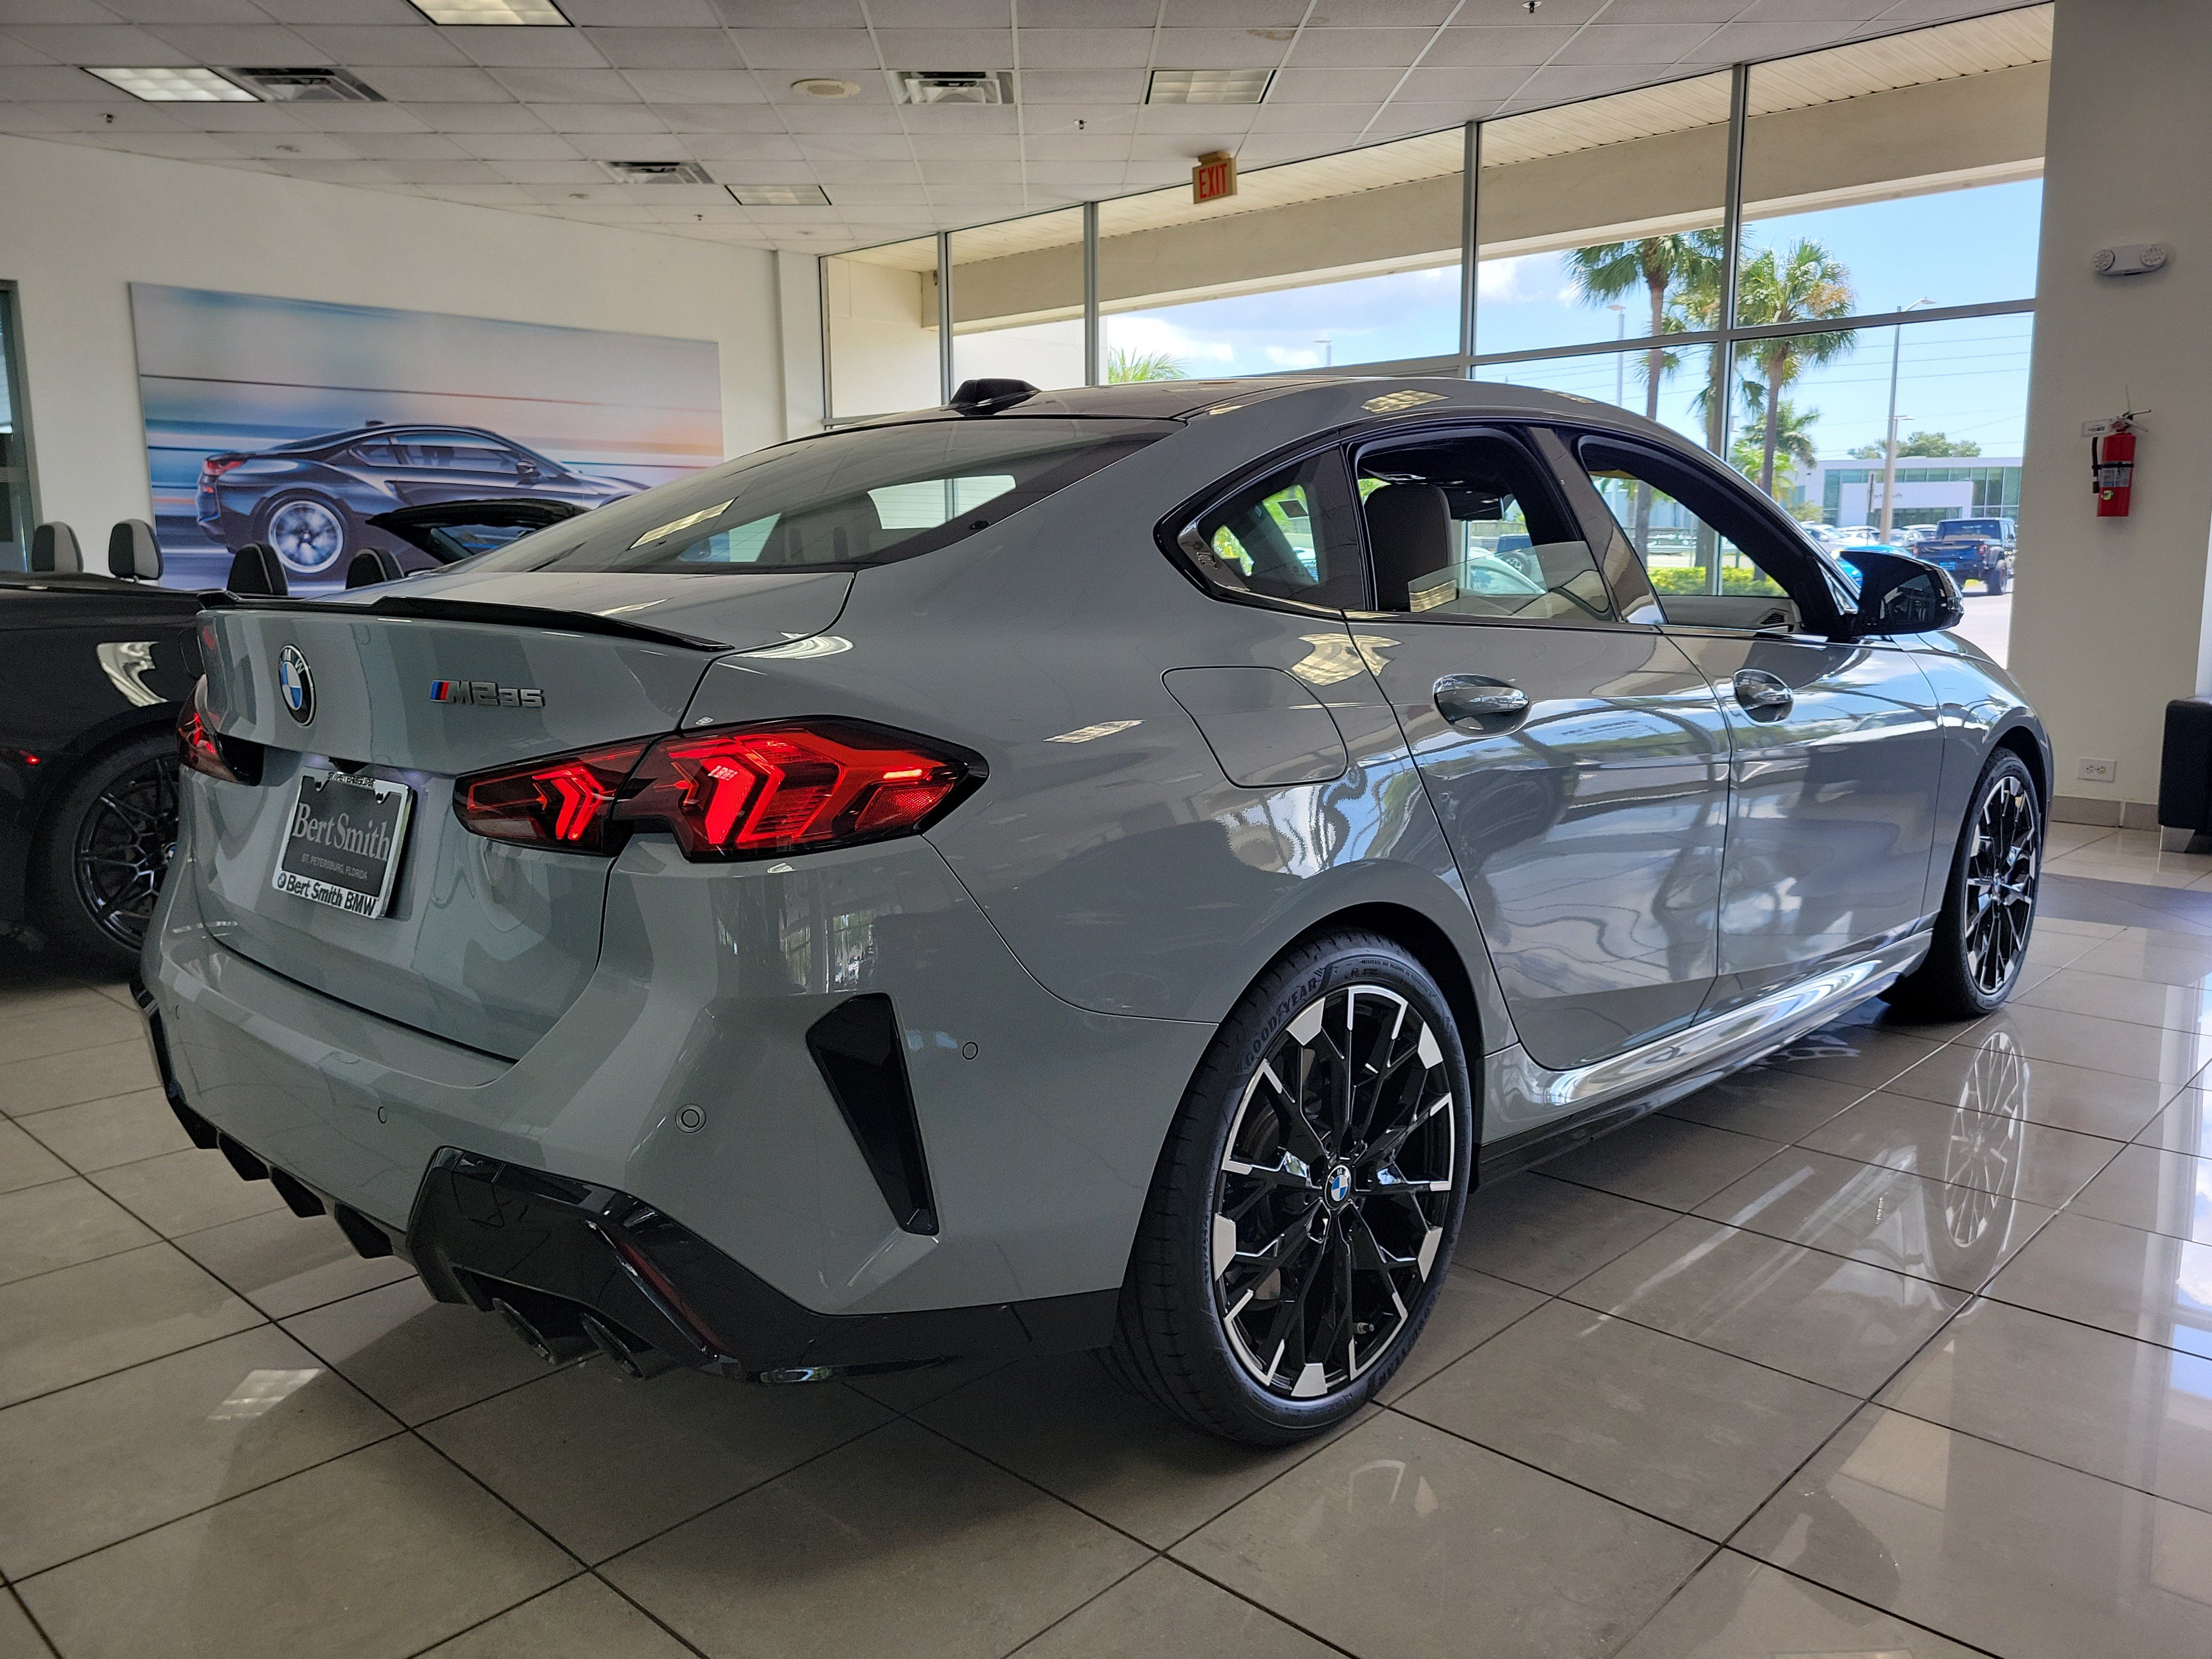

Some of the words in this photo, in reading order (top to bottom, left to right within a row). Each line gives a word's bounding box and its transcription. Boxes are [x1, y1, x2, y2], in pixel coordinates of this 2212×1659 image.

[1198, 163, 1227, 198] EXIT
[443, 680, 545, 708] M235
[292, 803, 335, 845] Bert
[334, 813, 390, 861] Smith
[286, 874, 310, 898] Bert
[311, 882, 343, 907] Smith
[344, 891, 377, 916] BMW
